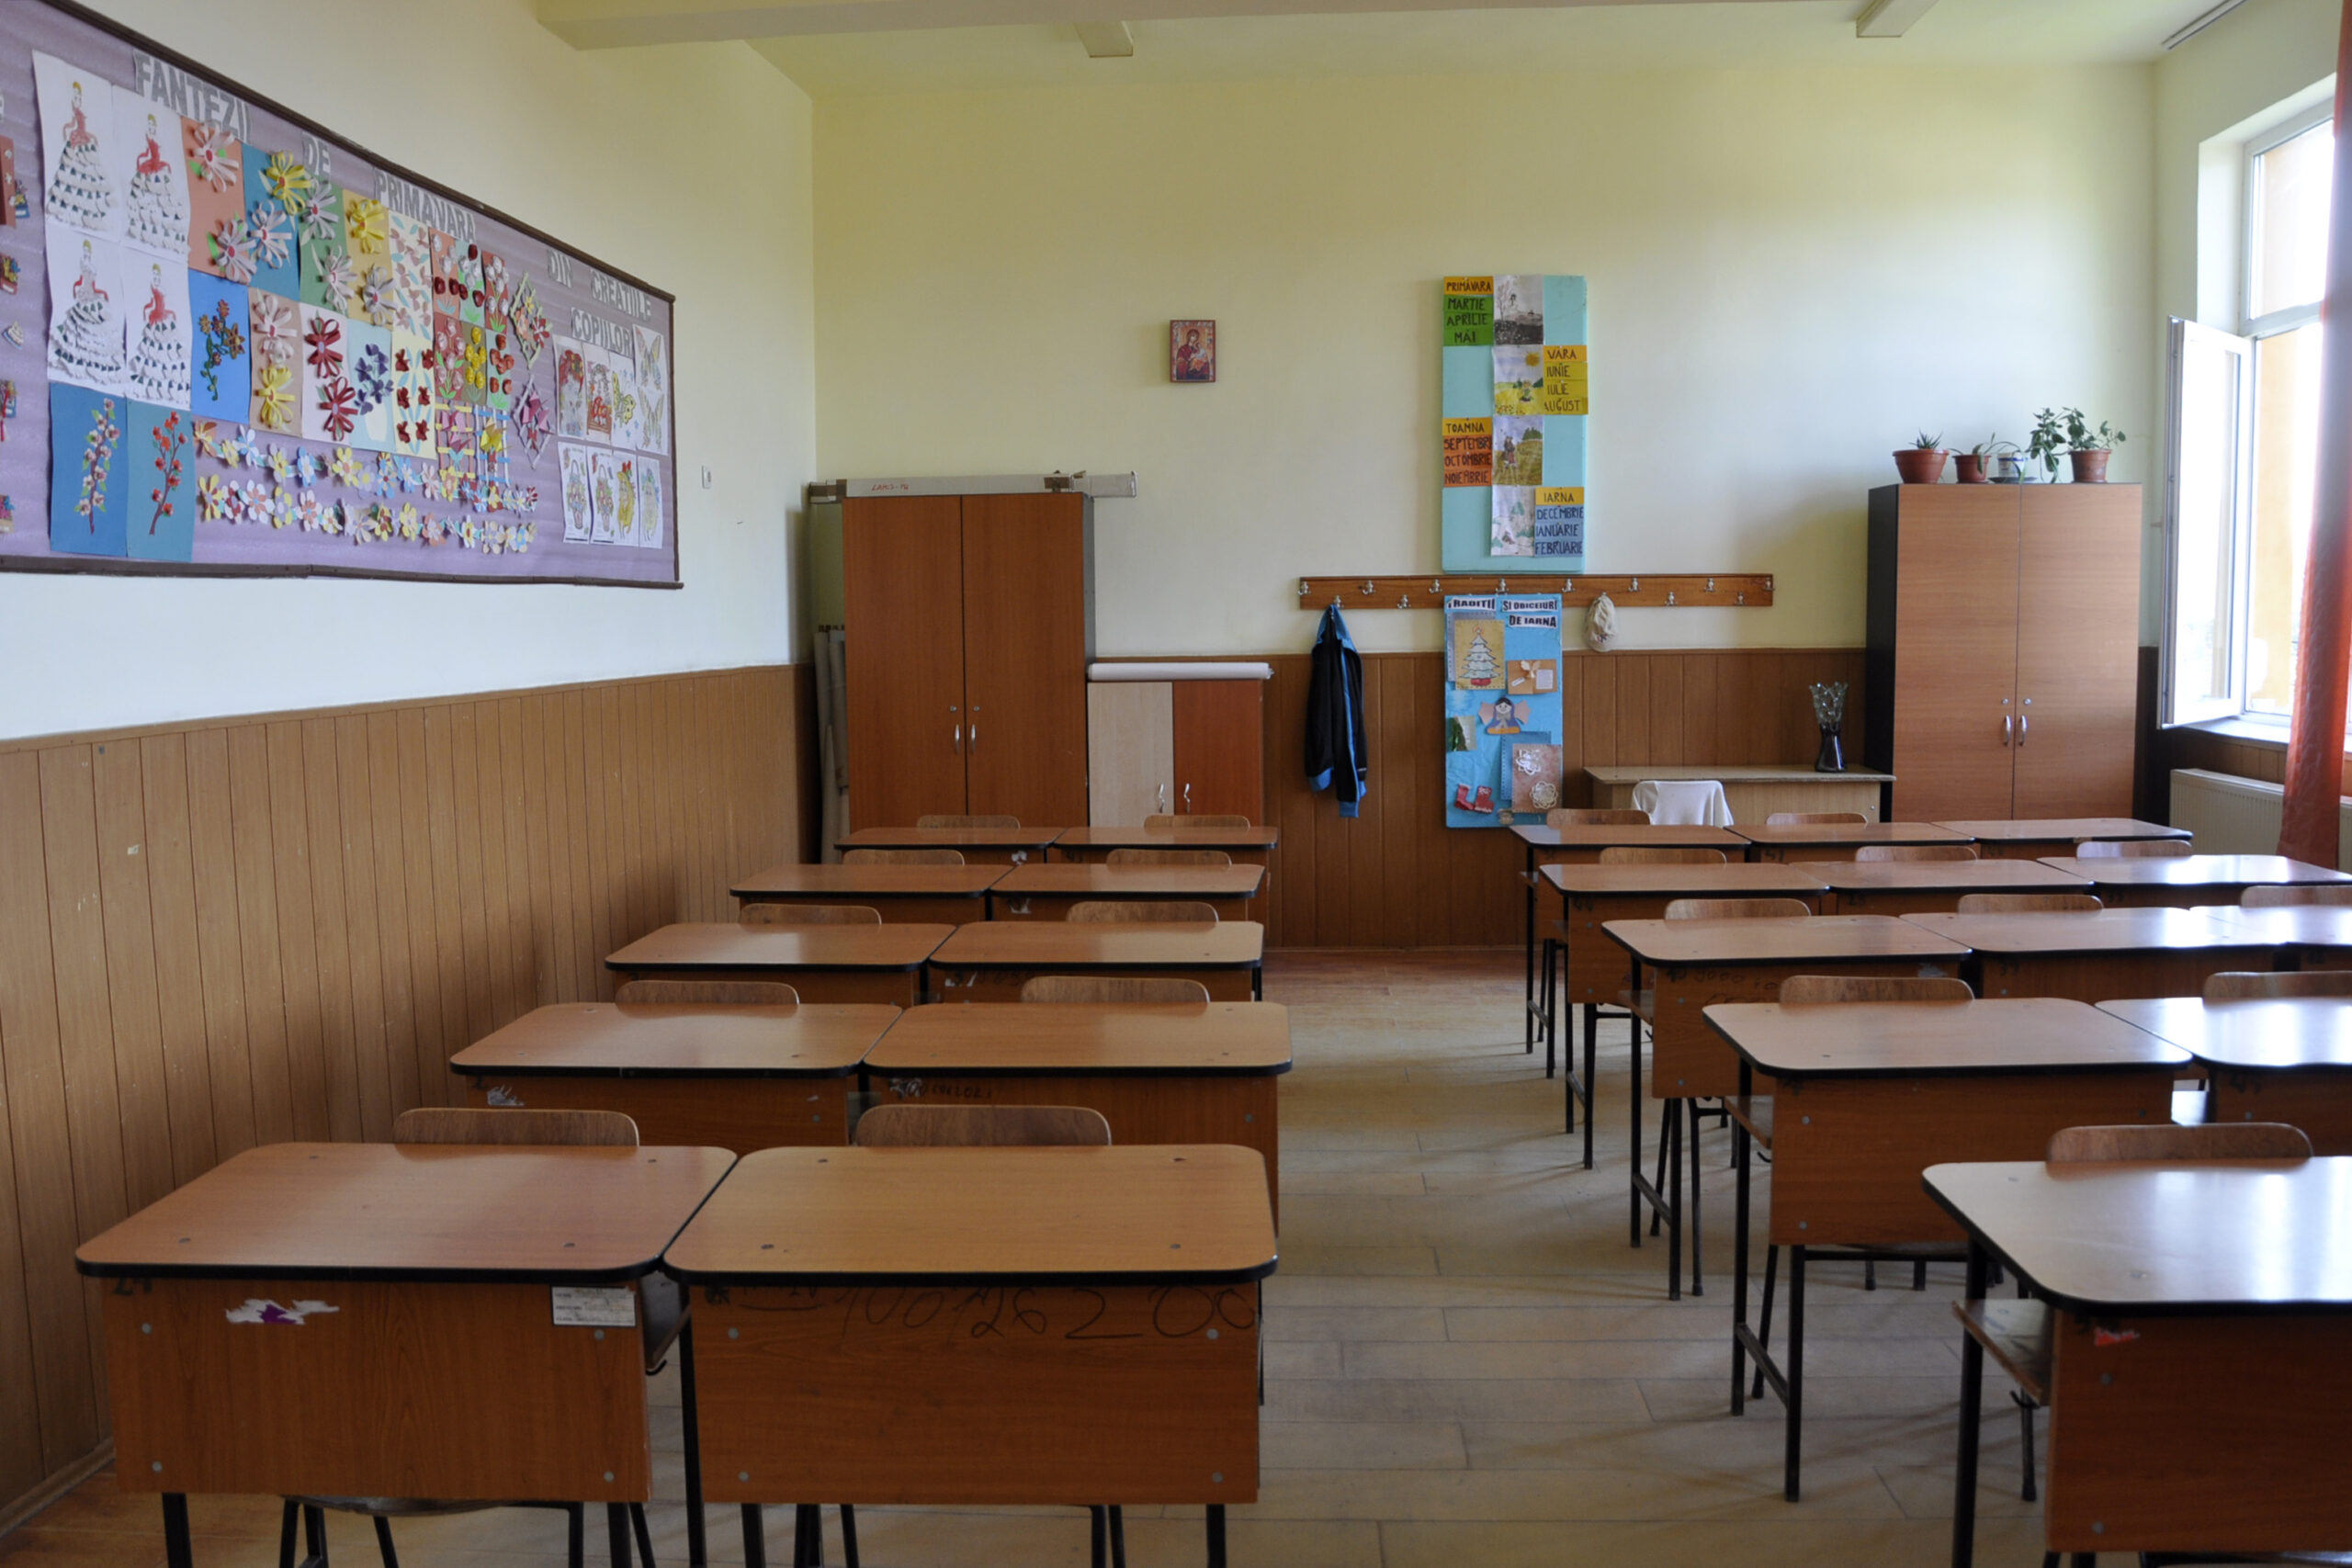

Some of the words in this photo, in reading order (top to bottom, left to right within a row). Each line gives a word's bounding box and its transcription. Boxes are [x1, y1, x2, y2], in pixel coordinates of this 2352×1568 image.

[135, 52, 249, 142] FANTEZII
[304, 134, 331, 177] DE
[1447, 297, 1486, 310] MARTIE
[1446, 312, 1488, 326] APRILIE
[1453, 331, 1476, 344] MAI
[1546, 348, 1577, 360] VARA
[1546, 365, 1571, 378] IUNIE
[1547, 382, 1569, 395] IULIE
[1544, 399, 1580, 412] AUGUST
[1445, 422, 1485, 434] TOAMNA
[1544, 491, 1575, 502] IARNA
[1536, 507, 1584, 520] DECEMBRIE
[1535, 524, 1579, 537] IANUARIE
[1535, 540, 1583, 555] FEBRUARIE
[1509, 615, 1521, 626] DE
[1524, 615, 1556, 627] IARNA
